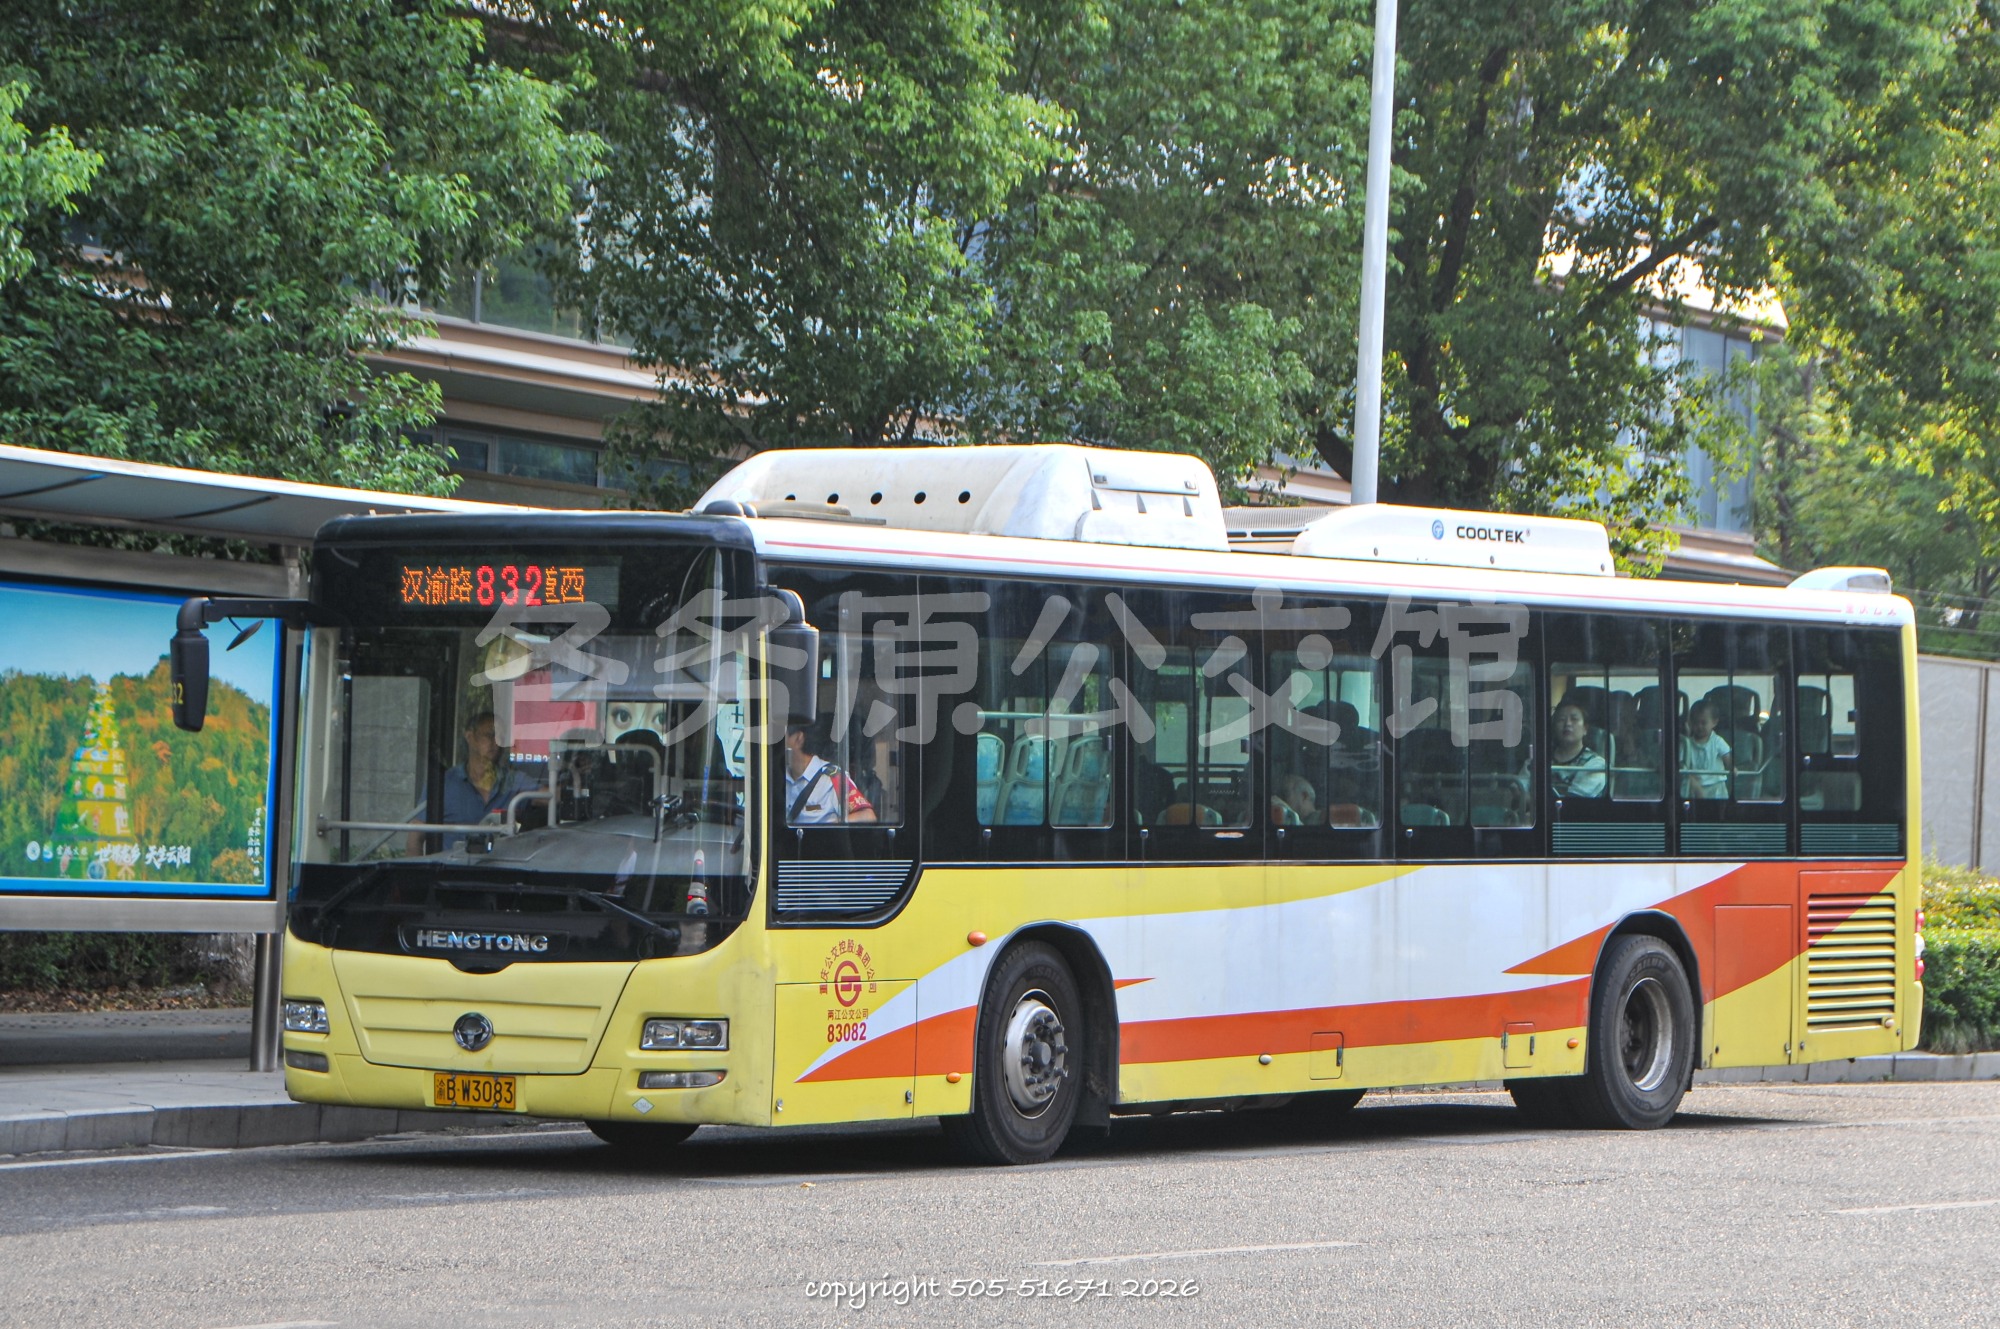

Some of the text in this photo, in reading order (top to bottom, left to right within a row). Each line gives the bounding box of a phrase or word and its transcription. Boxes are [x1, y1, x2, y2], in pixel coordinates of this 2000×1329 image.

[1456, 526, 1525, 543] COOLTEK
[401, 566, 473, 605] 汉渝路
[476, 565, 542, 606] 832
[416, 929, 548, 952] HENGTONG
[827, 1008, 869, 1020] 两江公交公司
[826, 1021, 867, 1043] 83082
